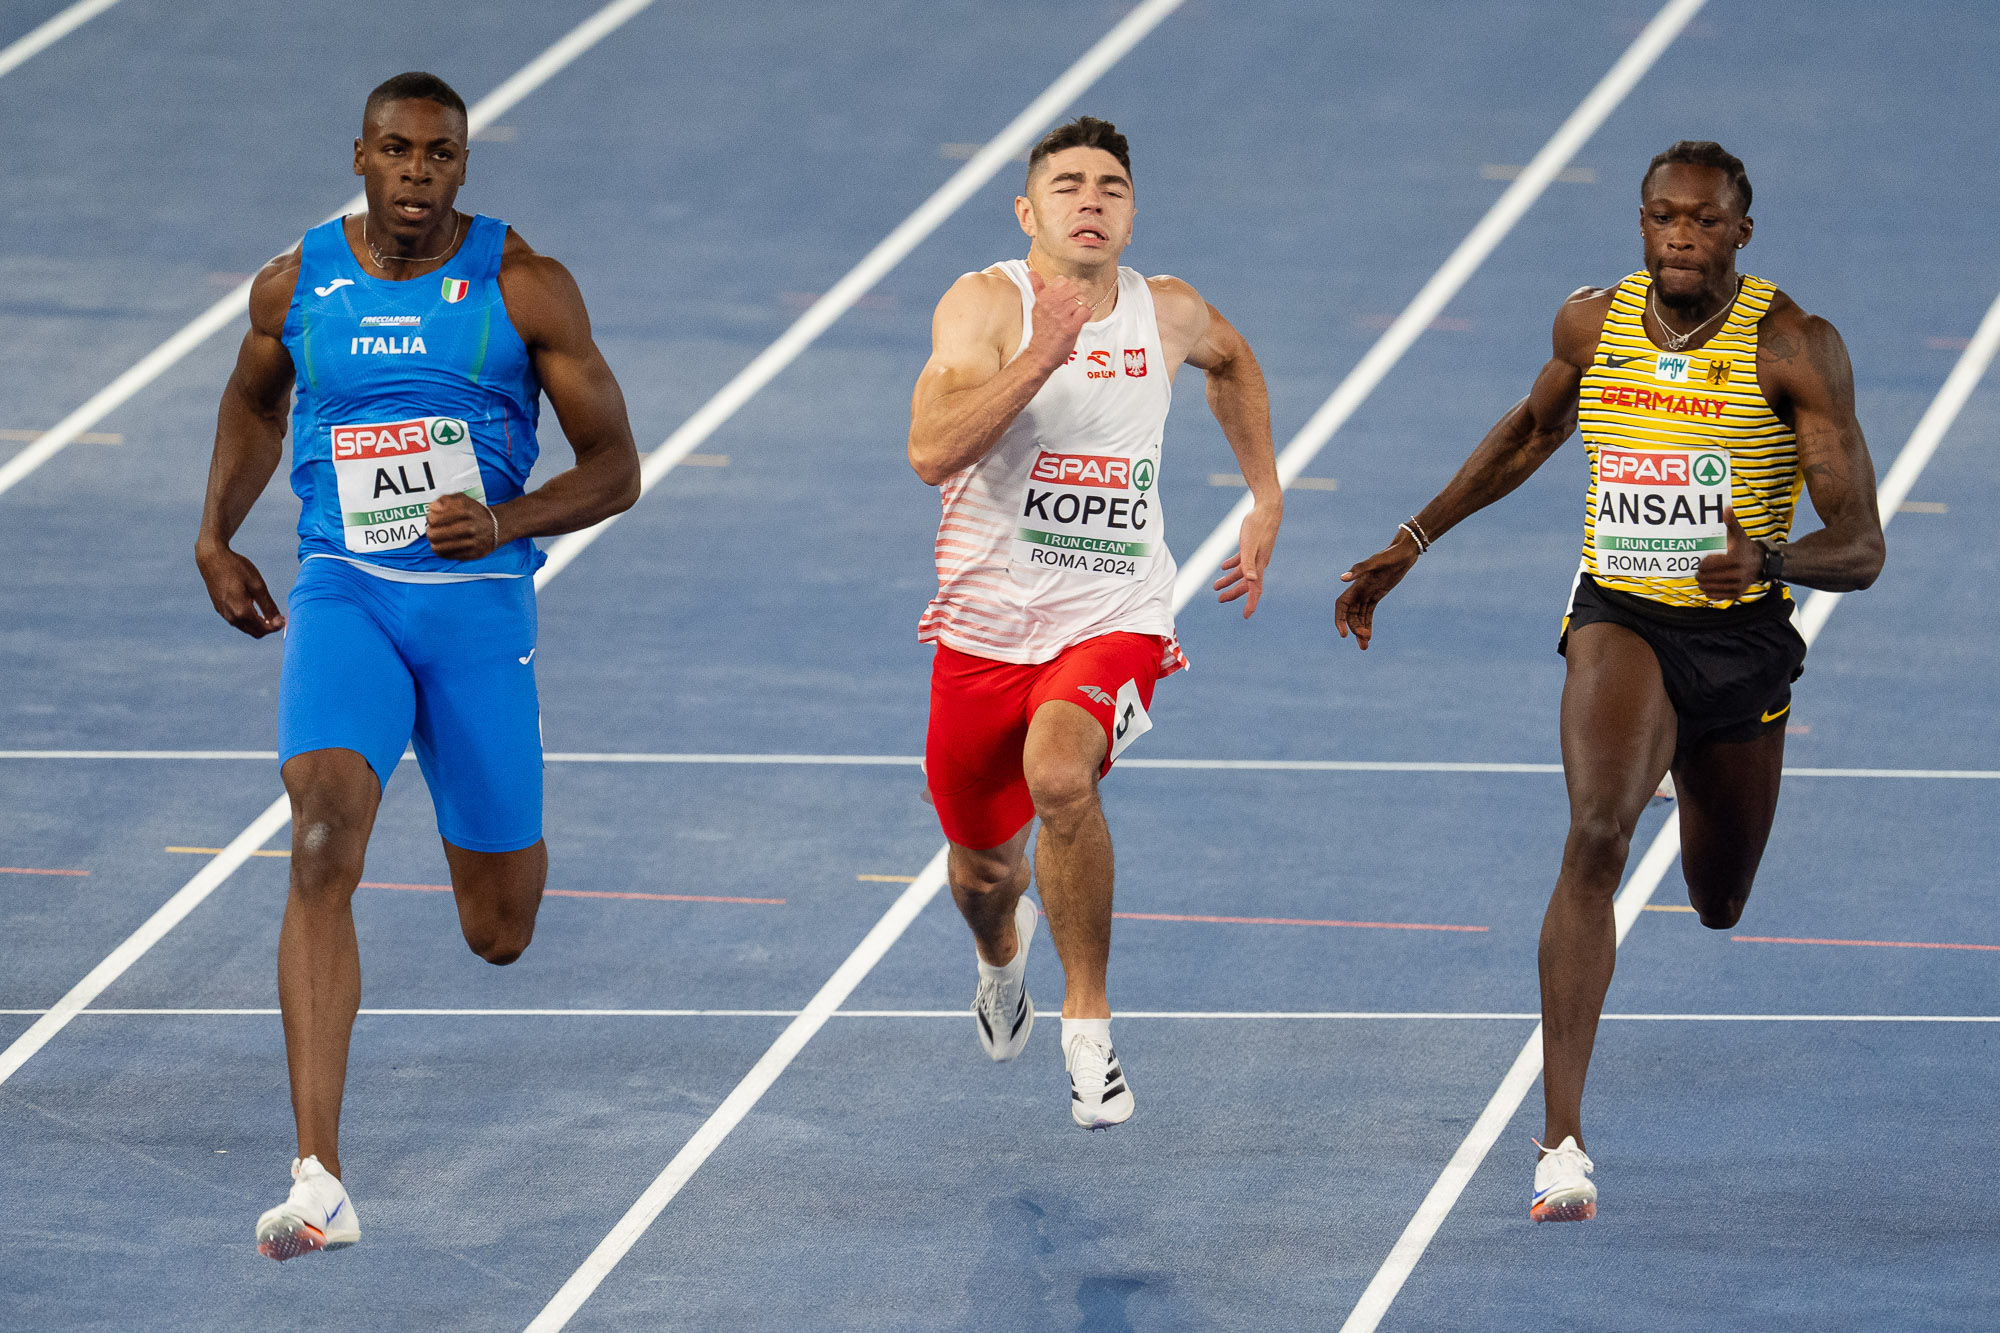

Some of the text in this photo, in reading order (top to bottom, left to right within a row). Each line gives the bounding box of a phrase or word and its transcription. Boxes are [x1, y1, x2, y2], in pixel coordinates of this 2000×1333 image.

[350, 336, 427, 355] ITALIA
[1087, 370, 1116, 379] ORLEN
[1600, 386, 1728, 419] GERMANY
[336, 425, 427, 456] SPAR
[373, 461, 436, 499] ALI
[1034, 457, 1128, 485] SPAR
[1601, 454, 1687, 482] SPAR
[368, 513, 373, 524] I
[374, 506, 405, 523] RUN
[1023, 488, 1148, 530] KOPEĆ
[1598, 491, 1724, 526] ANSAH
[364, 524, 421, 545] ROMA
[1044, 533, 1051, 544] I
[1051, 535, 1080, 548] RUN
[1615, 538, 1620, 549] I
[1621, 538, 1649, 550] RUN
[1031, 548, 1136, 576] ROMA 2024
[1607, 555, 1701, 572] ROMA 202
[1116, 702, 1135, 740] 5
